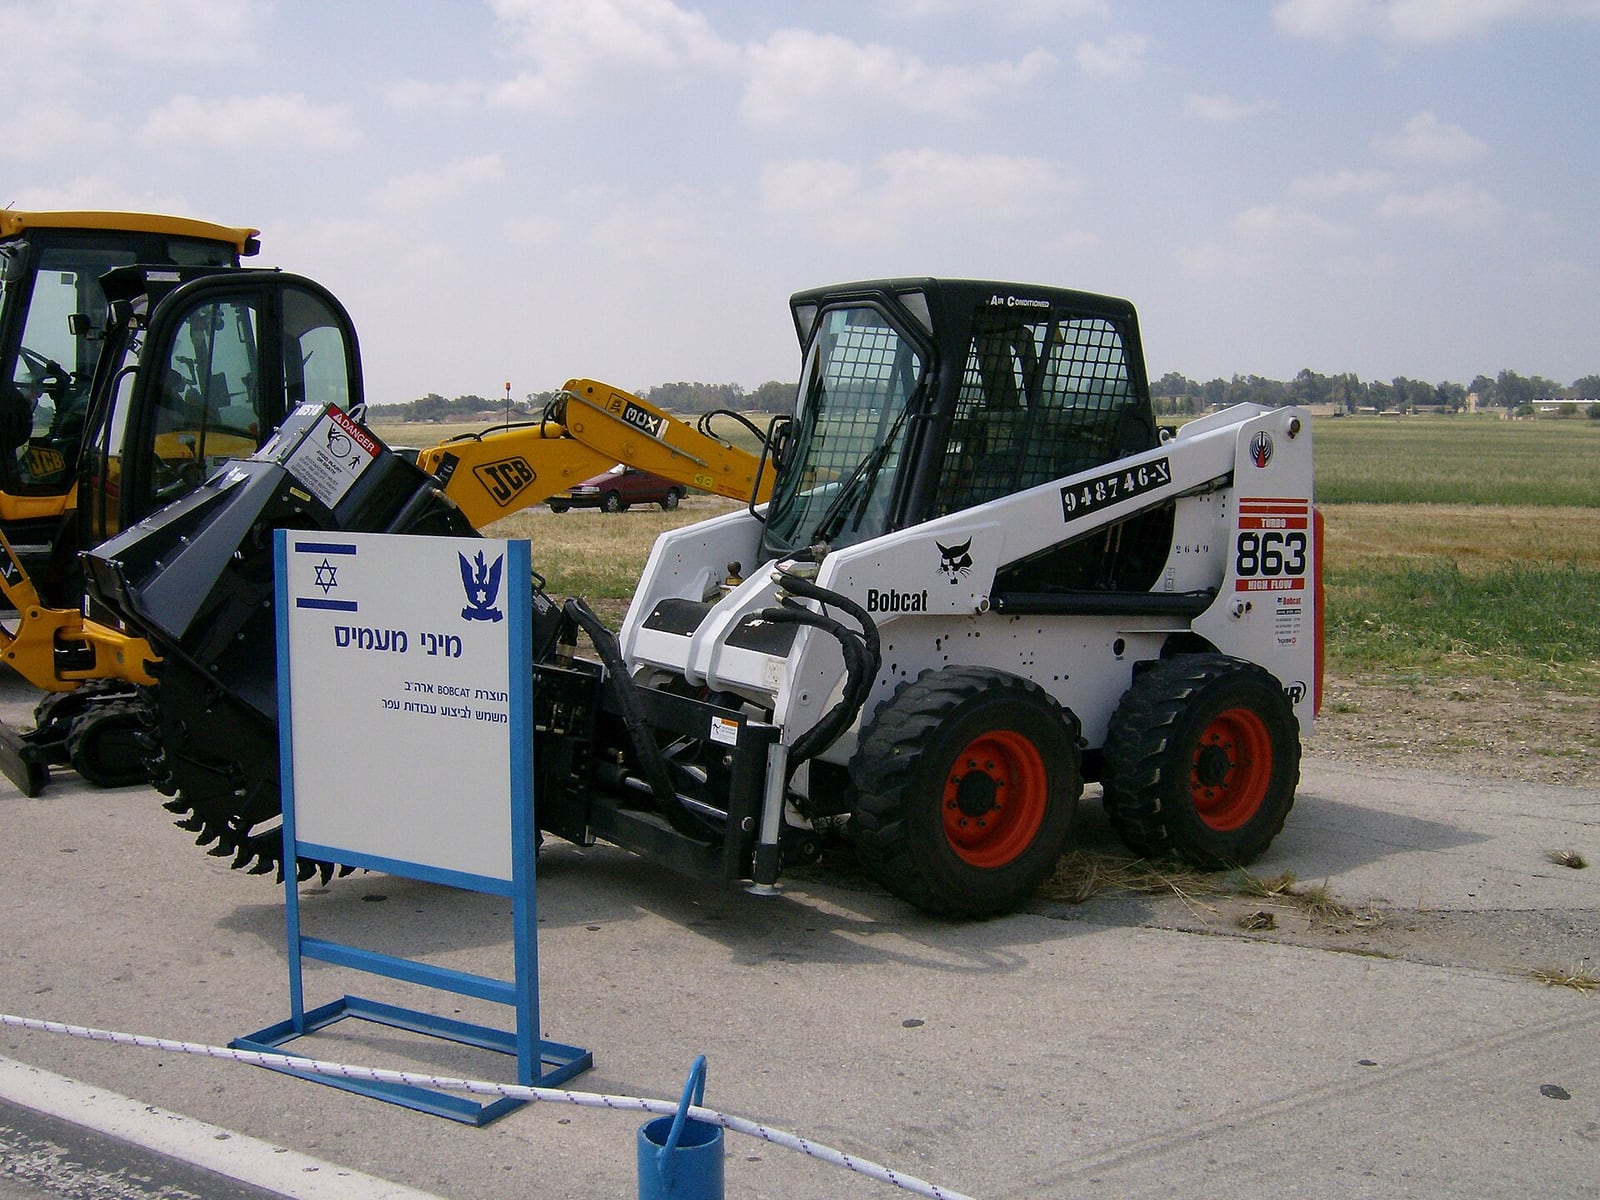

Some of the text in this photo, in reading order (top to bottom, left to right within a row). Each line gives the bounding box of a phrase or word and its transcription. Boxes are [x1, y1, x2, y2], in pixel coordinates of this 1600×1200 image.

[625, 407, 659, 433] 3CX
[340, 419, 375, 451] DANGER
[31, 448, 65, 475] JCB
[484, 460, 533, 501] JCB
[1236, 532, 1307, 576] 863
[1247, 580, 1293, 590] HIGH FLOW
[867, 588, 928, 612] Bobcat
[334, 625, 463, 659] מיני מעמיס
[437, 685, 470, 698] BOBCAT
[474, 689, 508, 702] תוצרת
[404, 701, 437, 714] עבודות
[440, 705, 472, 719] לביצוע
[475, 710, 508, 723] משמש
